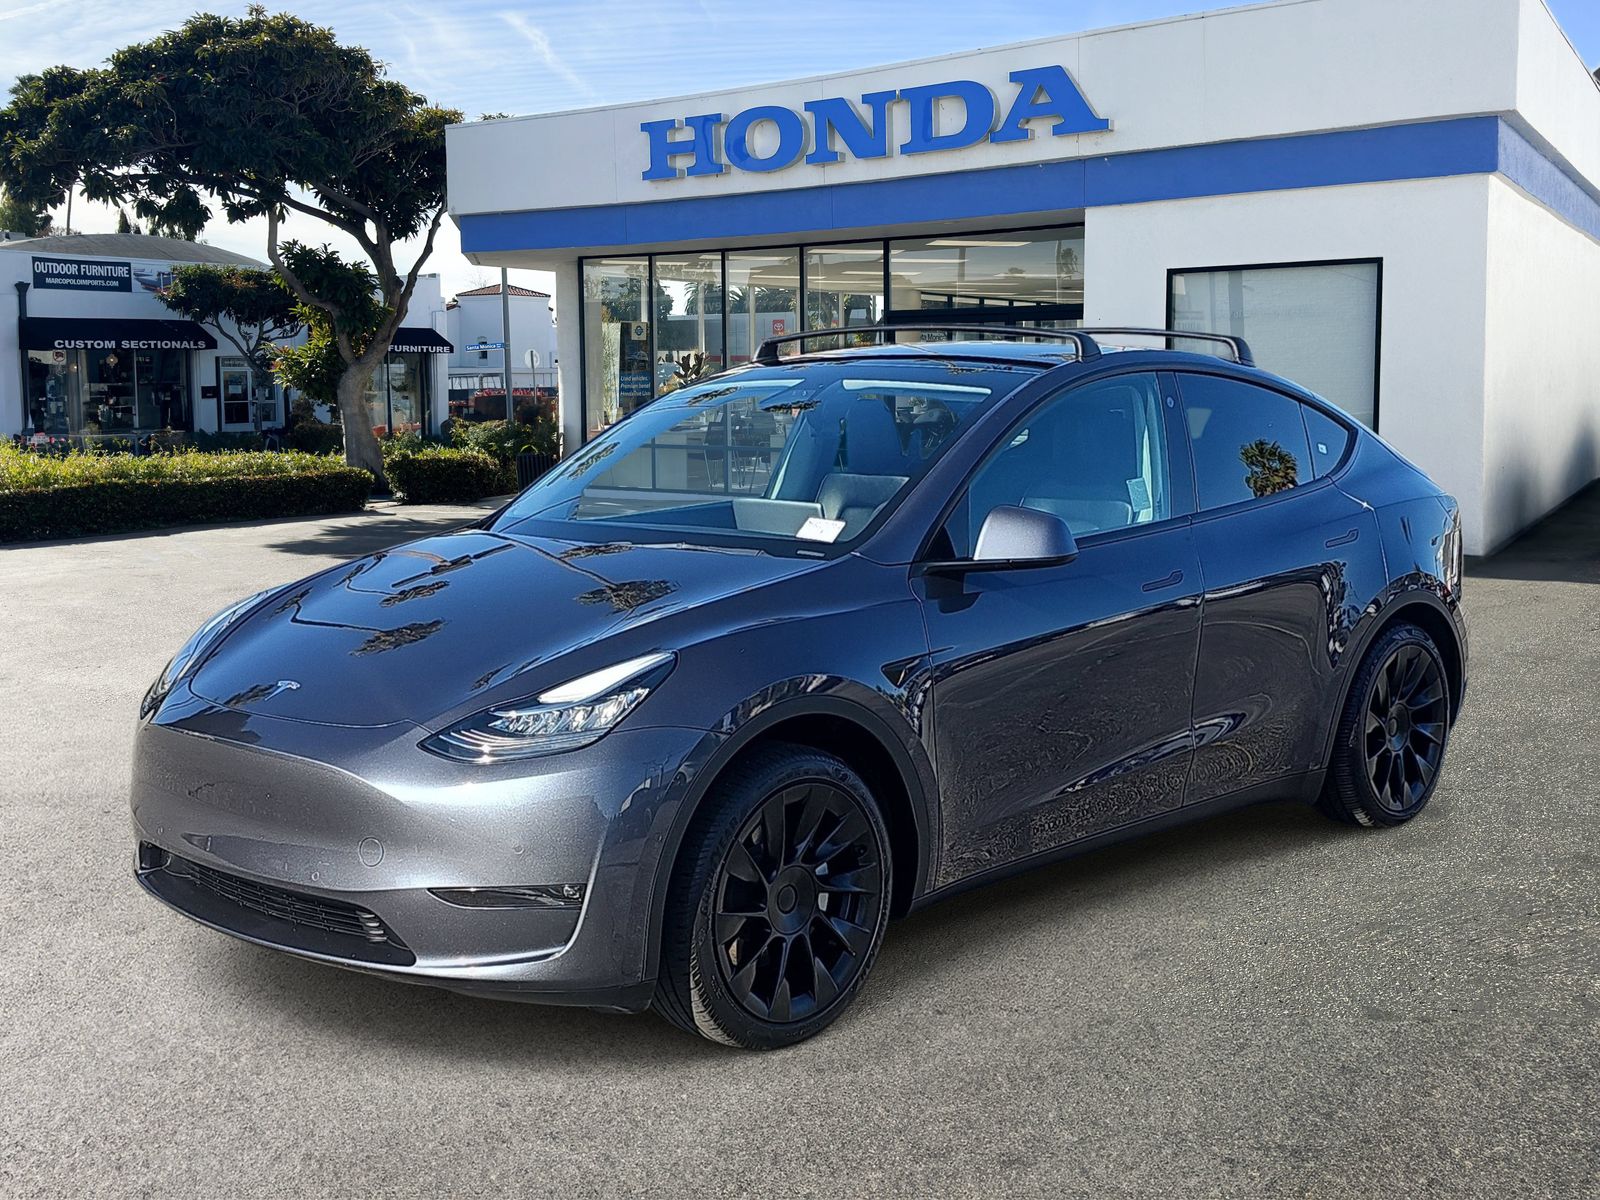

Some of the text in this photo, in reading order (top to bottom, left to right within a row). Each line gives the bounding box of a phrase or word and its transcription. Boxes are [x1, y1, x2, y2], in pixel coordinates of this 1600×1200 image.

[640, 65, 1113, 182] HONDA
[34, 261, 130, 278] OUTDOOR FURNITURE
[45, 277, 119, 287] MARCOPOLOIMPORTS.COM
[54, 339, 207, 350] CUSTOM SECTIONALS
[388, 344, 451, 353] FURNITURE
